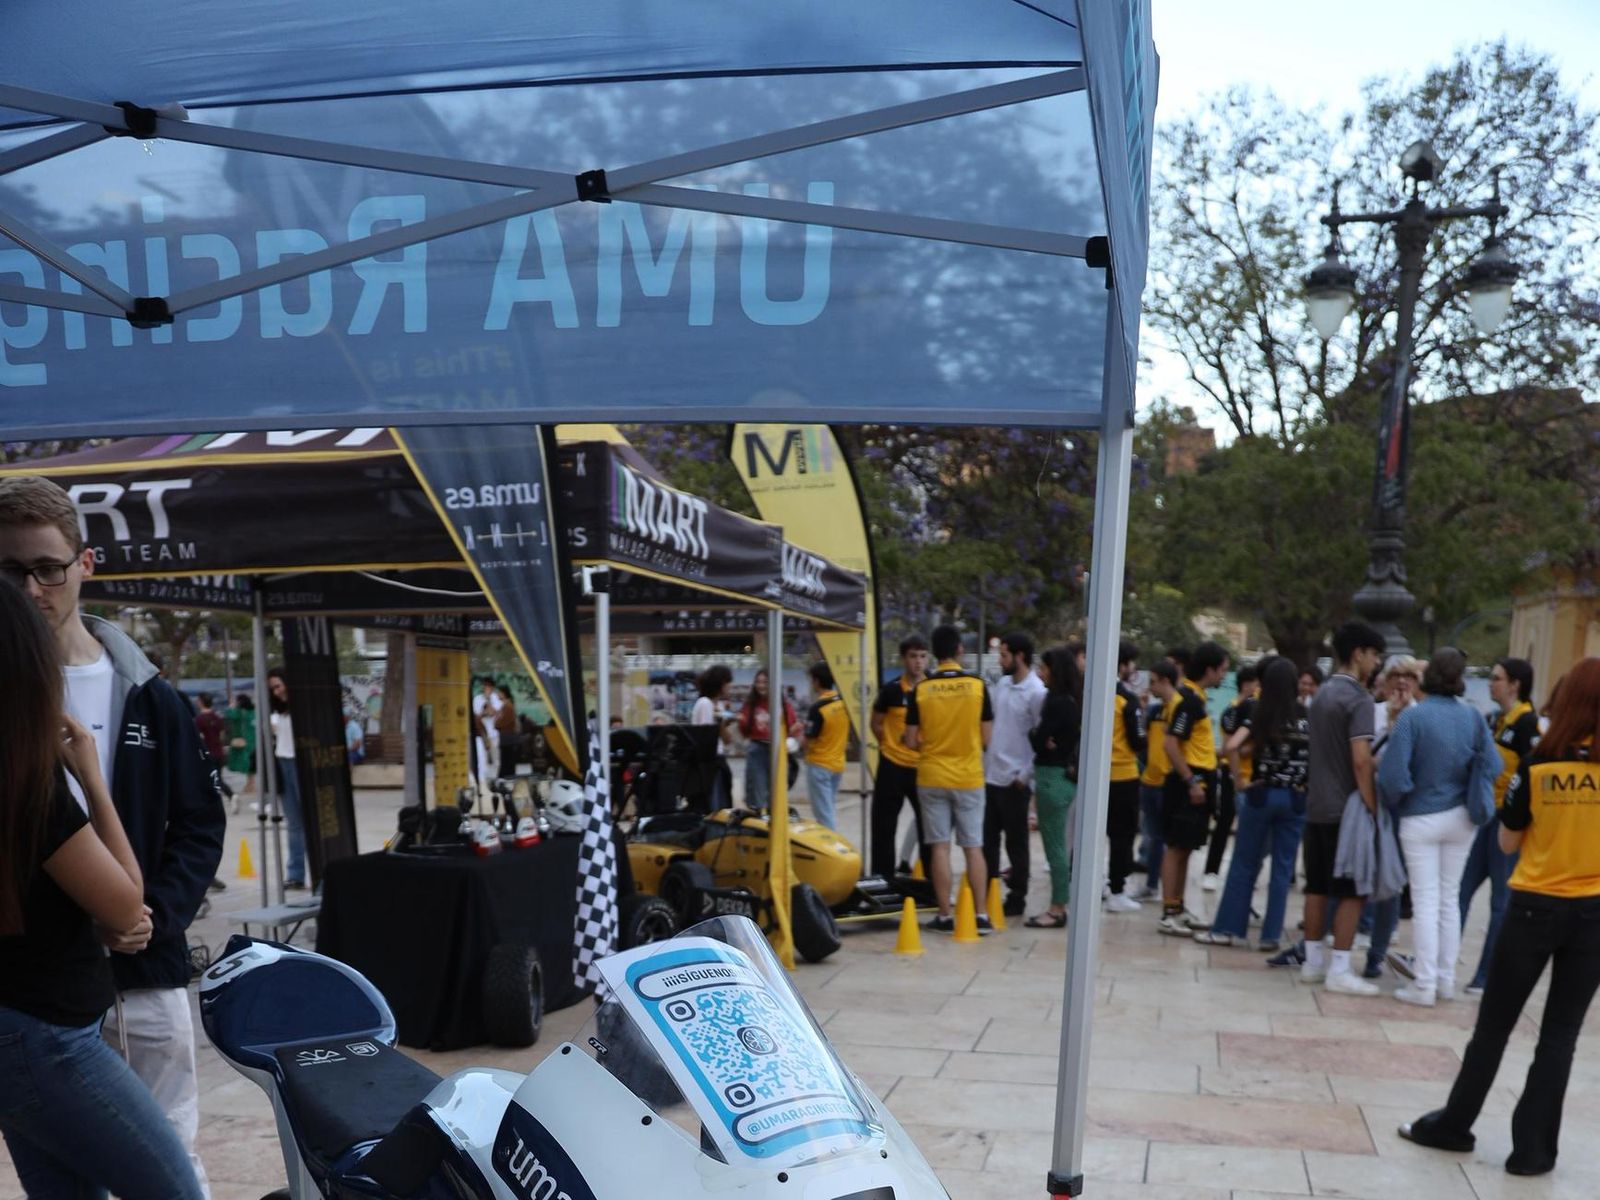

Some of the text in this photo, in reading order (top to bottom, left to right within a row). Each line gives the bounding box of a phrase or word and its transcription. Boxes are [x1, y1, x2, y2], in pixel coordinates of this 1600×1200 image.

[68, 478, 193, 543] RT
[622, 464, 709, 560] MART
[121, 542, 197, 563] TEAM
[1551, 773, 1600, 791] MA
